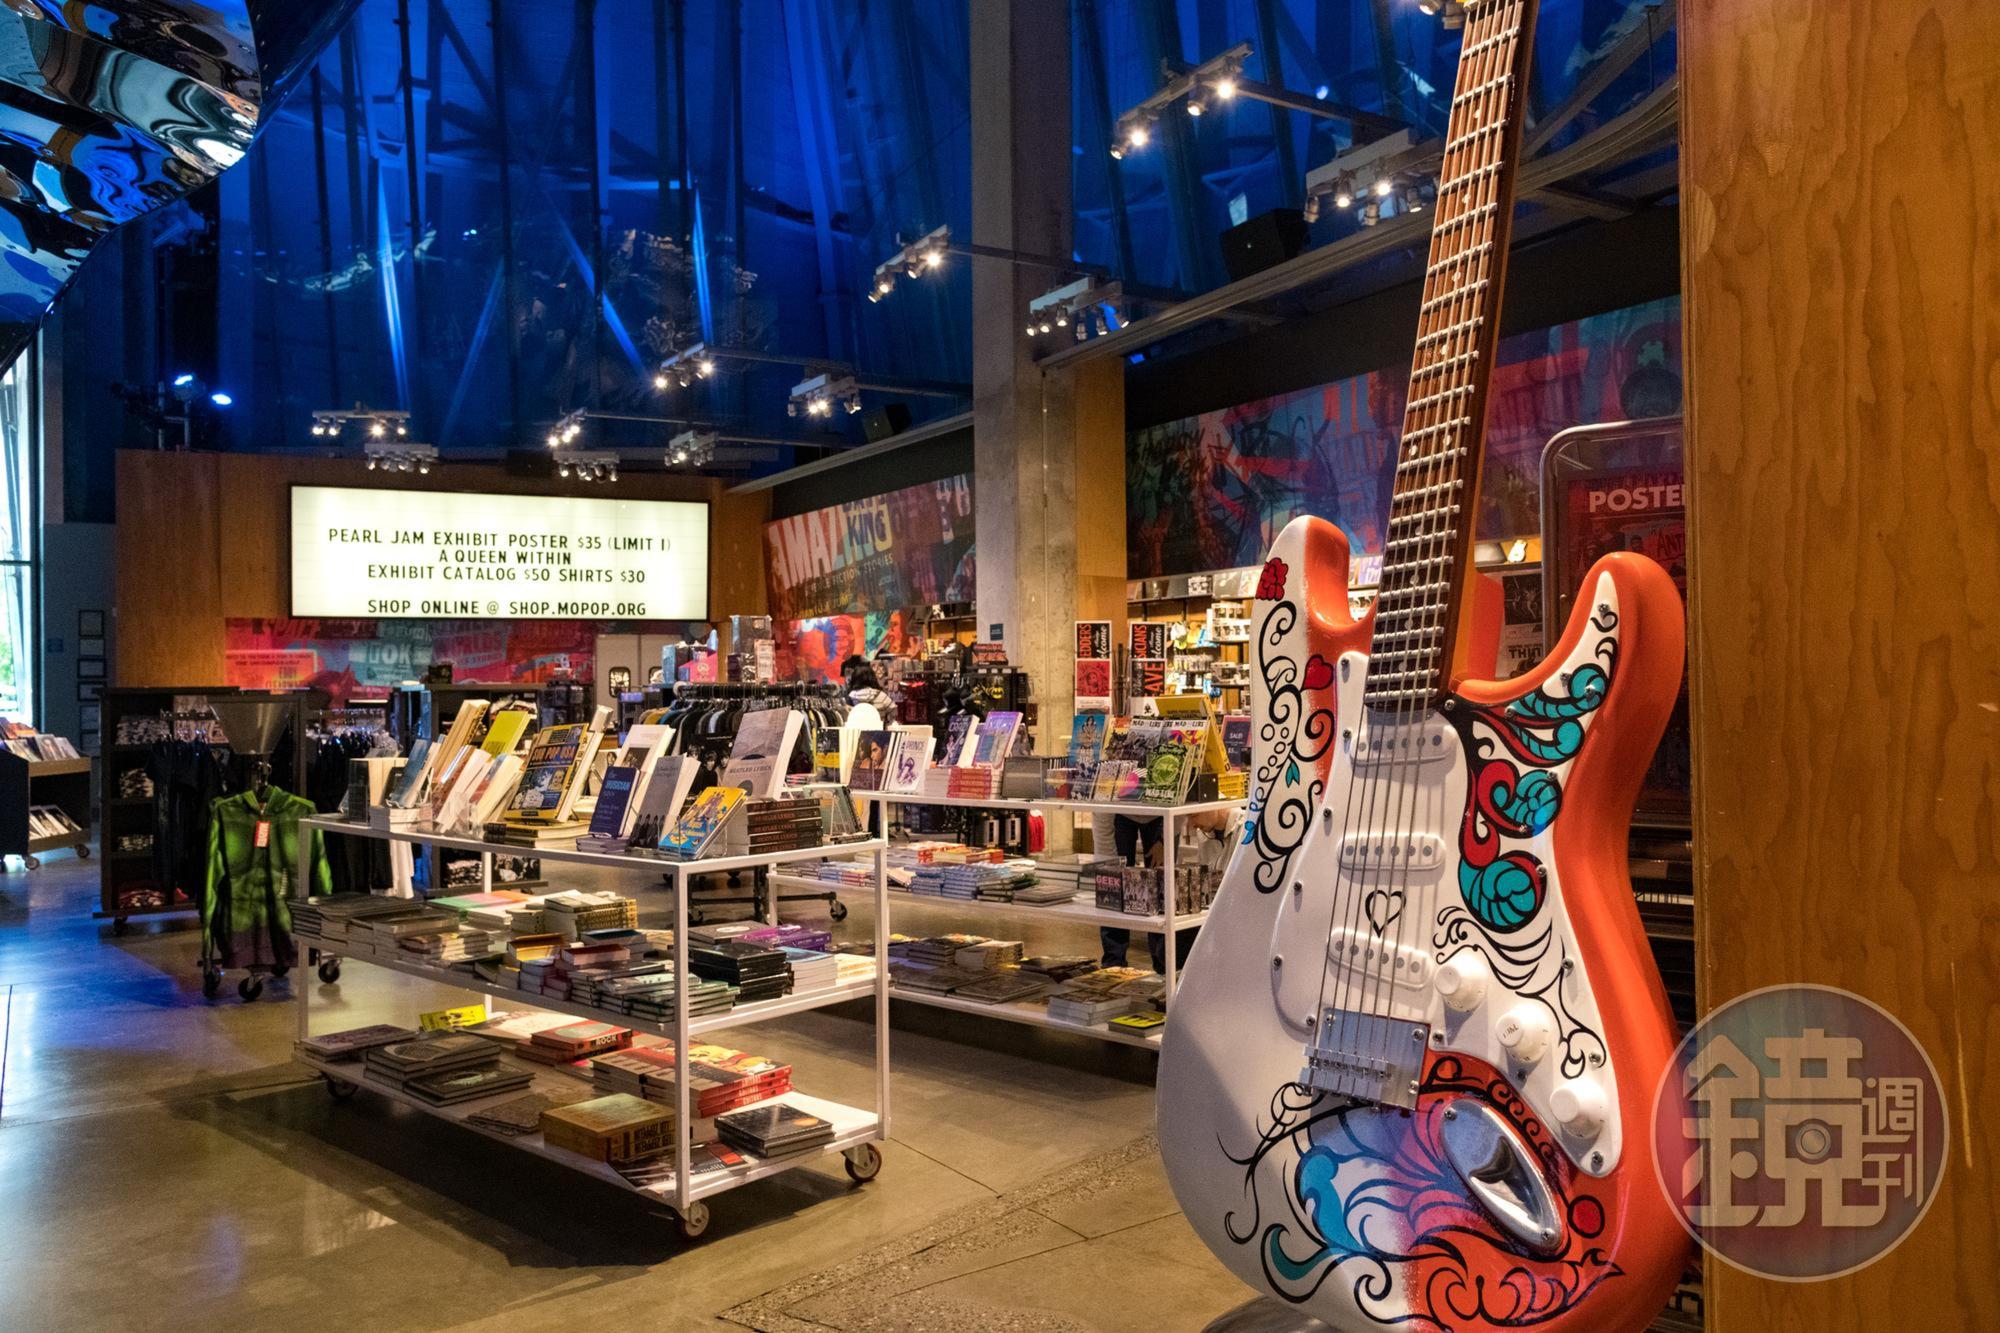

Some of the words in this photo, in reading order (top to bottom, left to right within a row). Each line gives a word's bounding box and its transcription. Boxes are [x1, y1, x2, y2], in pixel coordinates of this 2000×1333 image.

[329, 528, 382, 544] PEARL
[391, 530, 424, 545] JAM
[433, 531, 497, 547] EXHIBIT
[508, 533, 568, 549] POSTER
[577, 535, 602, 550] $35
[607, 536, 653, 551] (LIMIT
[439, 549, 448, 562] A
[454, 550, 507, 564] QUEEN
[516, 551, 571, 565] WITHIN
[368, 564, 435, 579] EXHIBIT
[442, 566, 516, 581] CATALOG
[524, 568, 551, 582] $50
[559, 568, 613, 583] SHIRTS
[620, 569, 646, 584] $30
[367, 599, 411, 614] SHOP
[421, 600, 479, 615] ONLINE
[486, 600, 499, 616] @
[509, 601, 646, 616] SHOP.MOPOP.ORG
[1096, 875, 1121, 886] GEEK
[596, 1034, 618, 1046] ROCK
